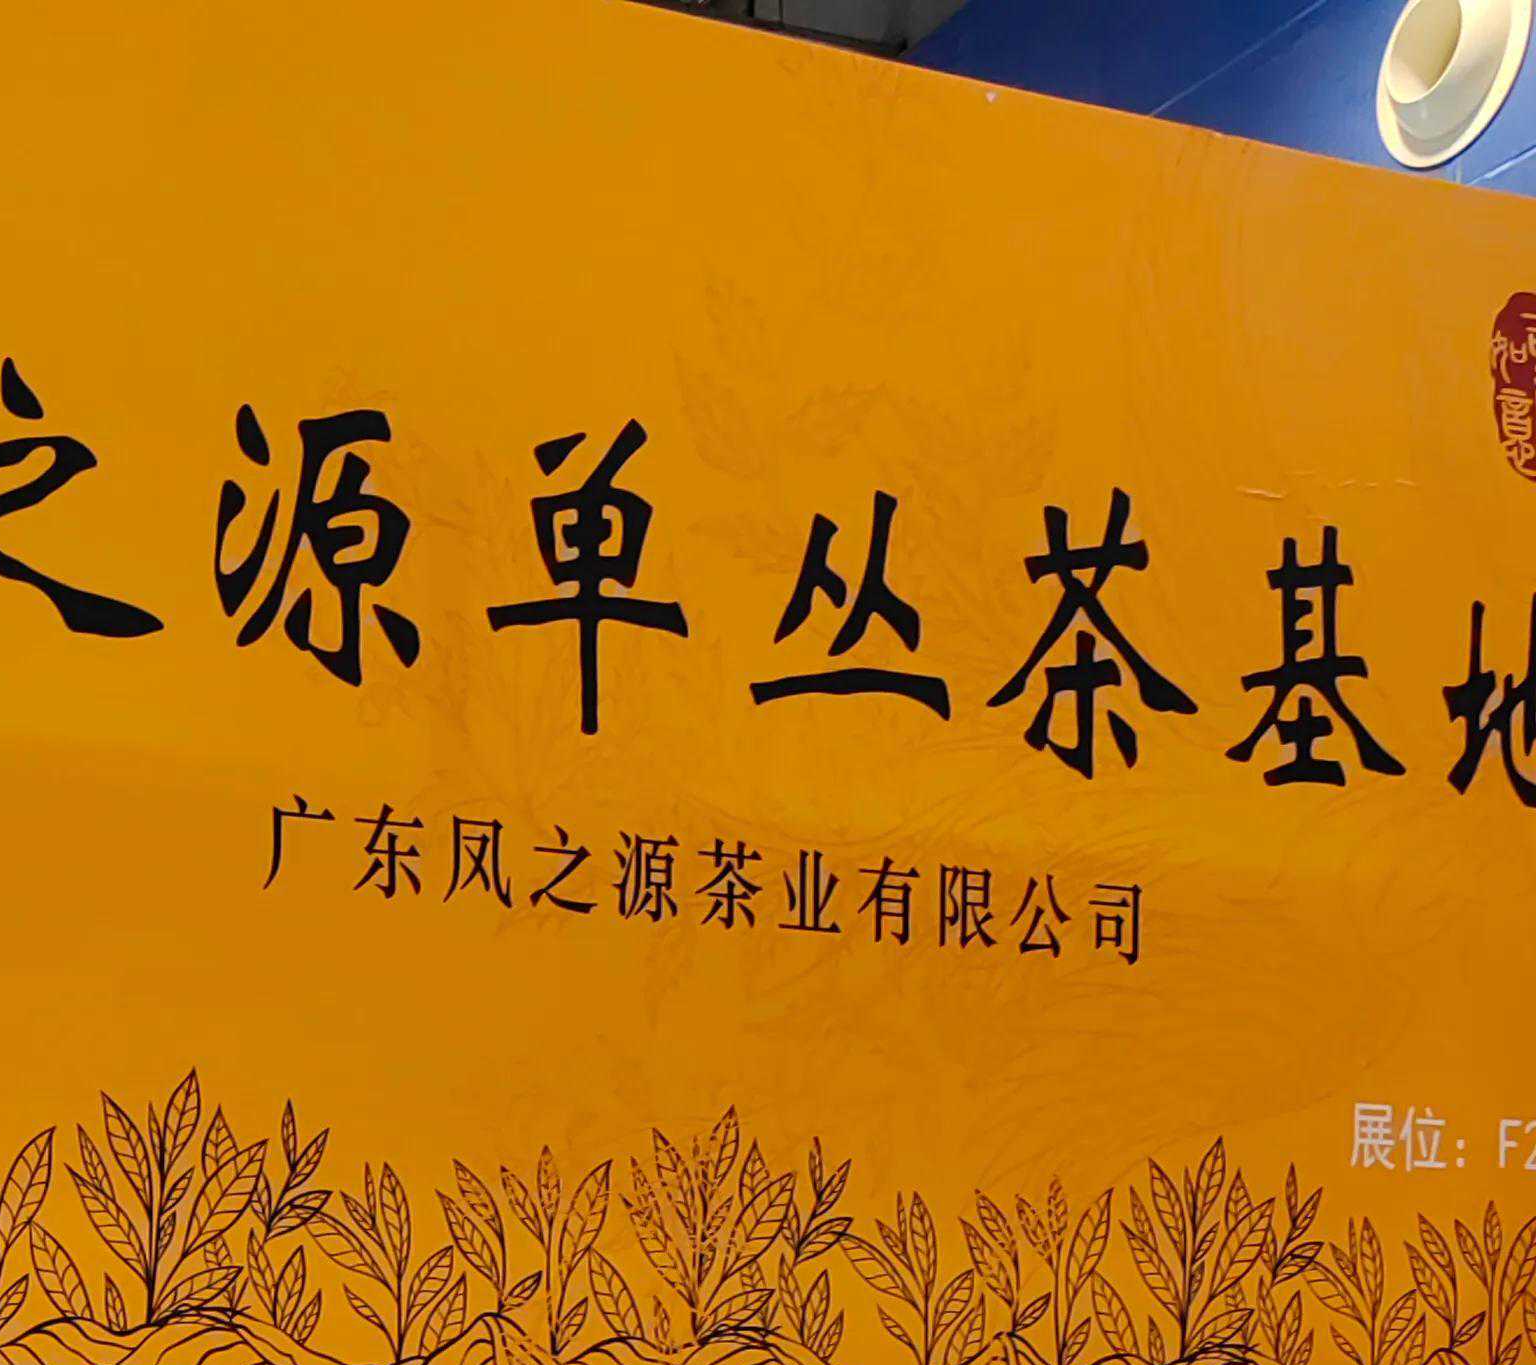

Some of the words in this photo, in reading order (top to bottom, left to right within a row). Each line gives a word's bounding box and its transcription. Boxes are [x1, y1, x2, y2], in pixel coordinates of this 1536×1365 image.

[263, 794, 1143, 965] 广东凤之源茶业有限公司
